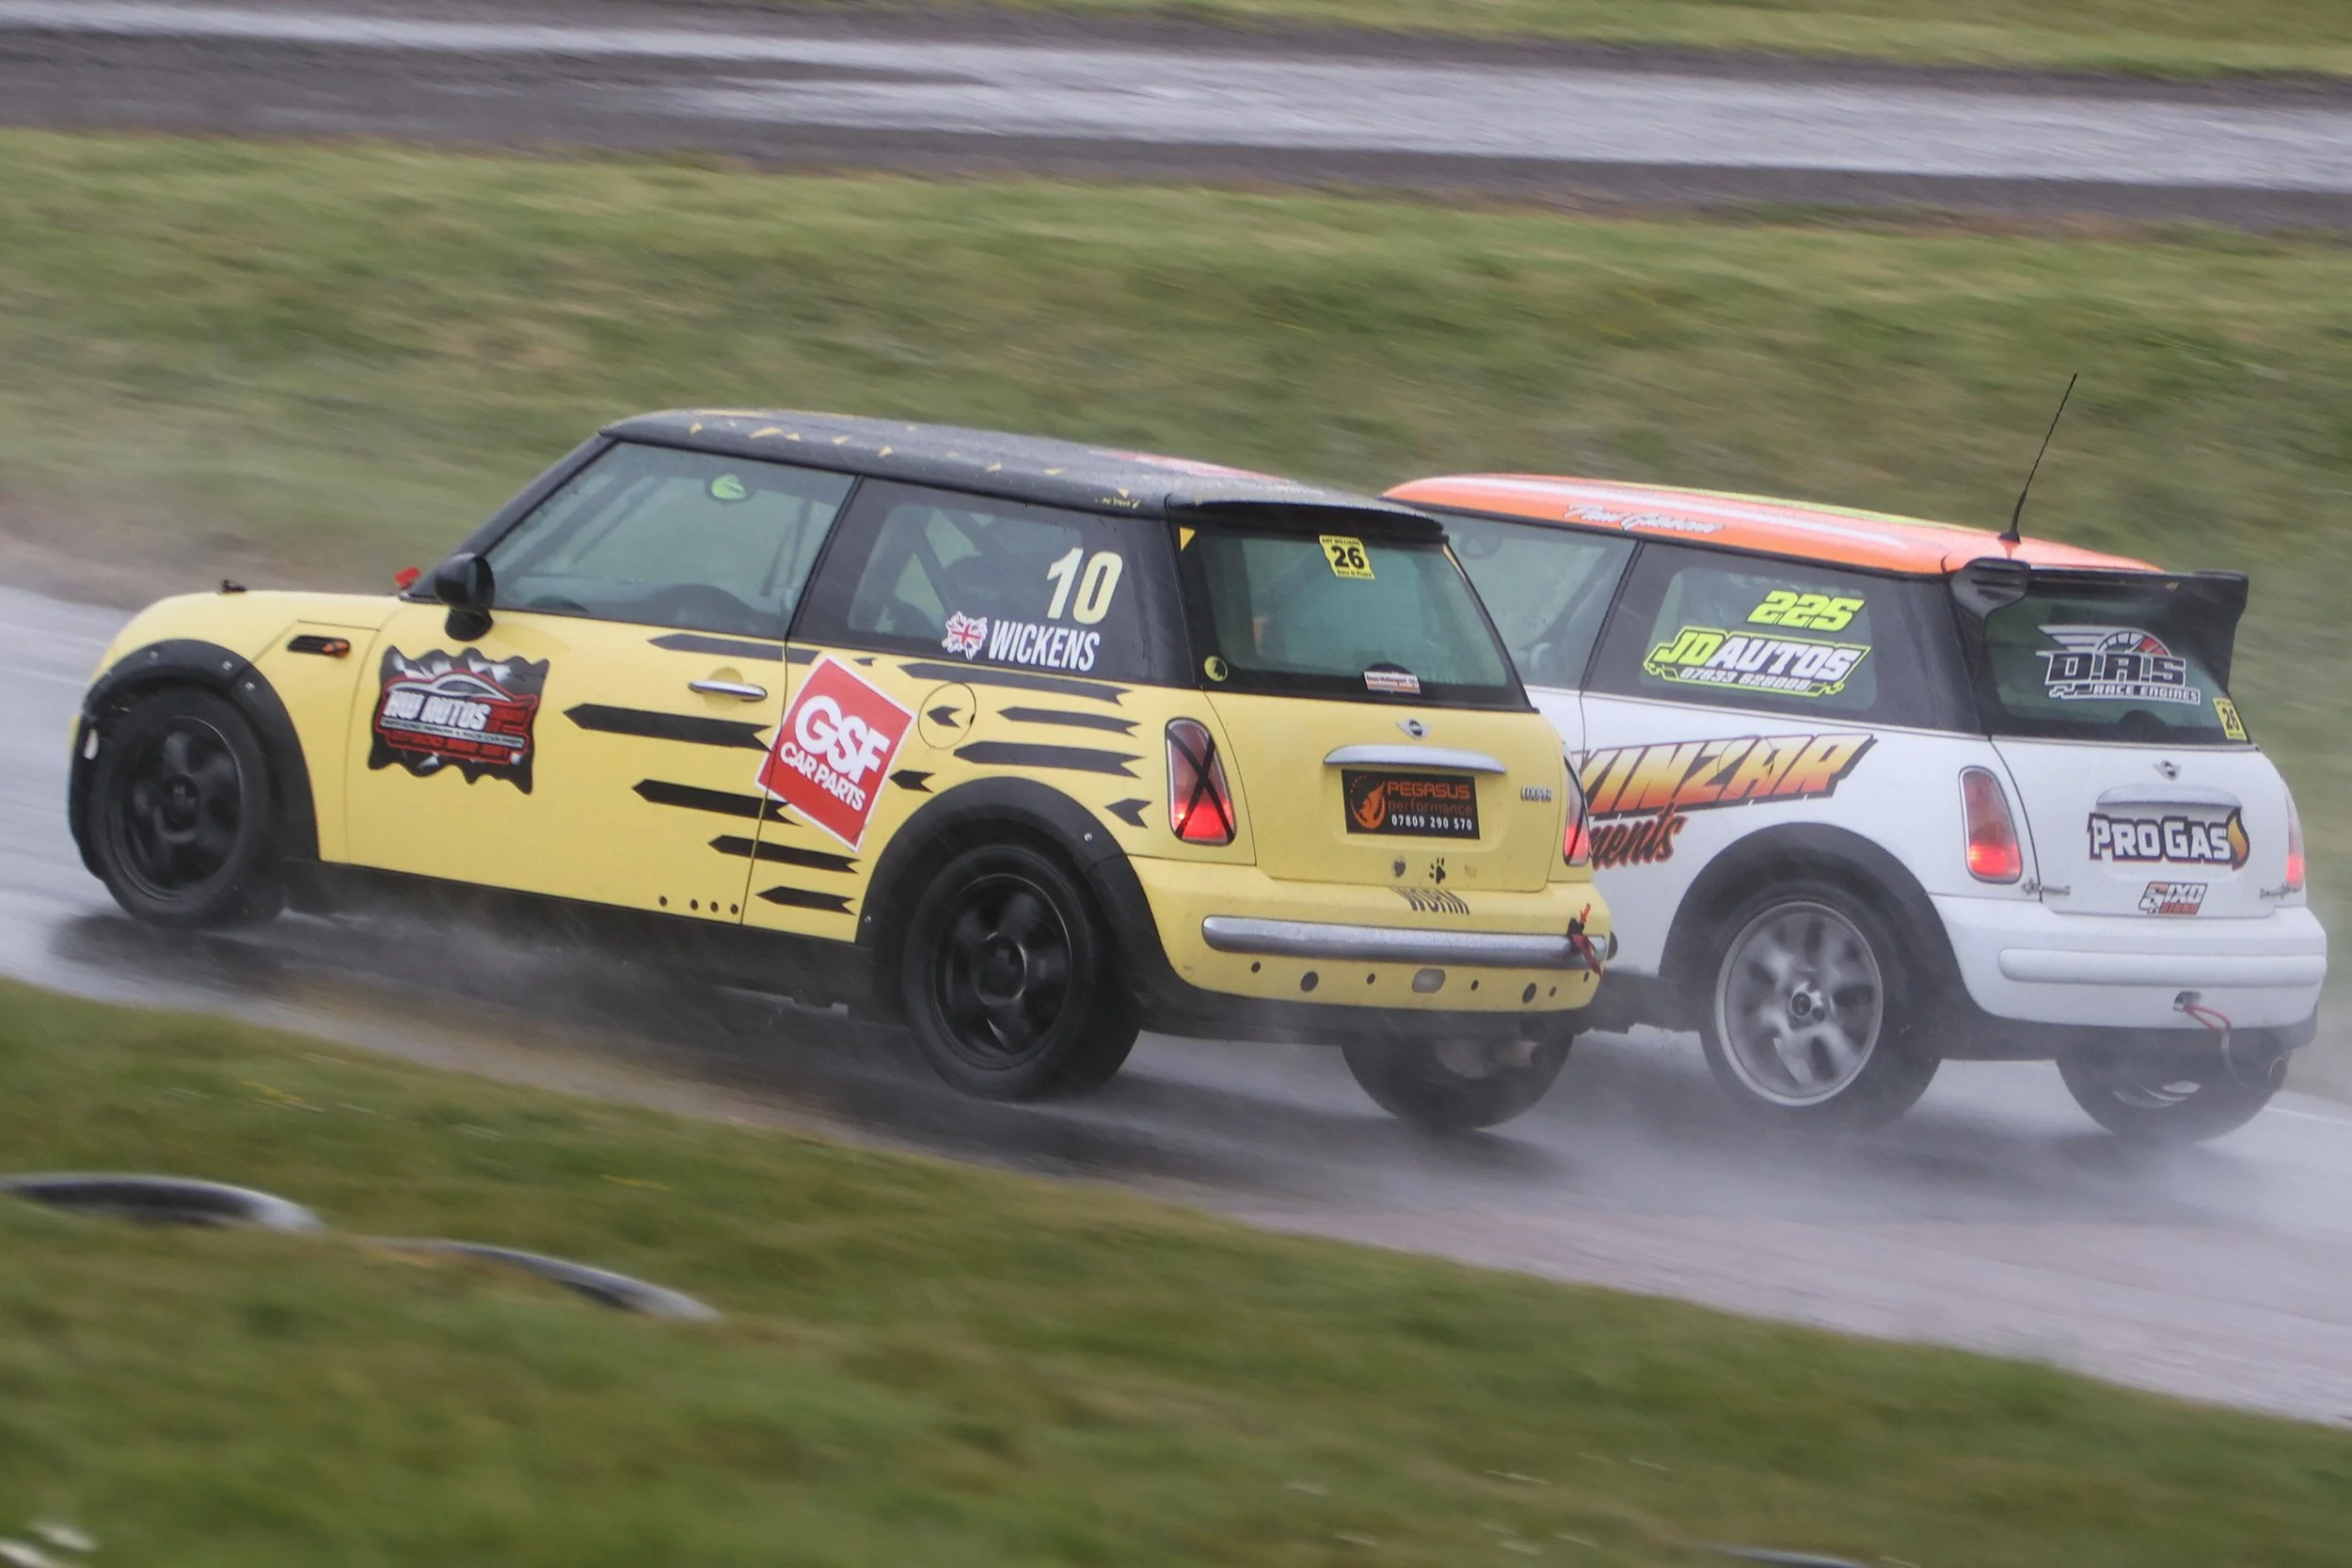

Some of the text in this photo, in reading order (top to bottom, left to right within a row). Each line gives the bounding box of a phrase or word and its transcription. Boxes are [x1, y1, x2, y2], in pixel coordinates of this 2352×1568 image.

[1330, 546, 1365, 569] 26
[1046, 546, 1123, 626] 10
[1747, 590, 1867, 631] 225
[988, 619, 1101, 672] WICKENS
[2221, 706, 2240, 731] 26
[795, 695, 891, 784] GSF
[780, 741, 866, 812] CAR PARTS
[1387, 781, 1470, 800] PEGASUS
[1387, 799, 1473, 816] performance
[1391, 814, 1473, 831] 07809 290 570
